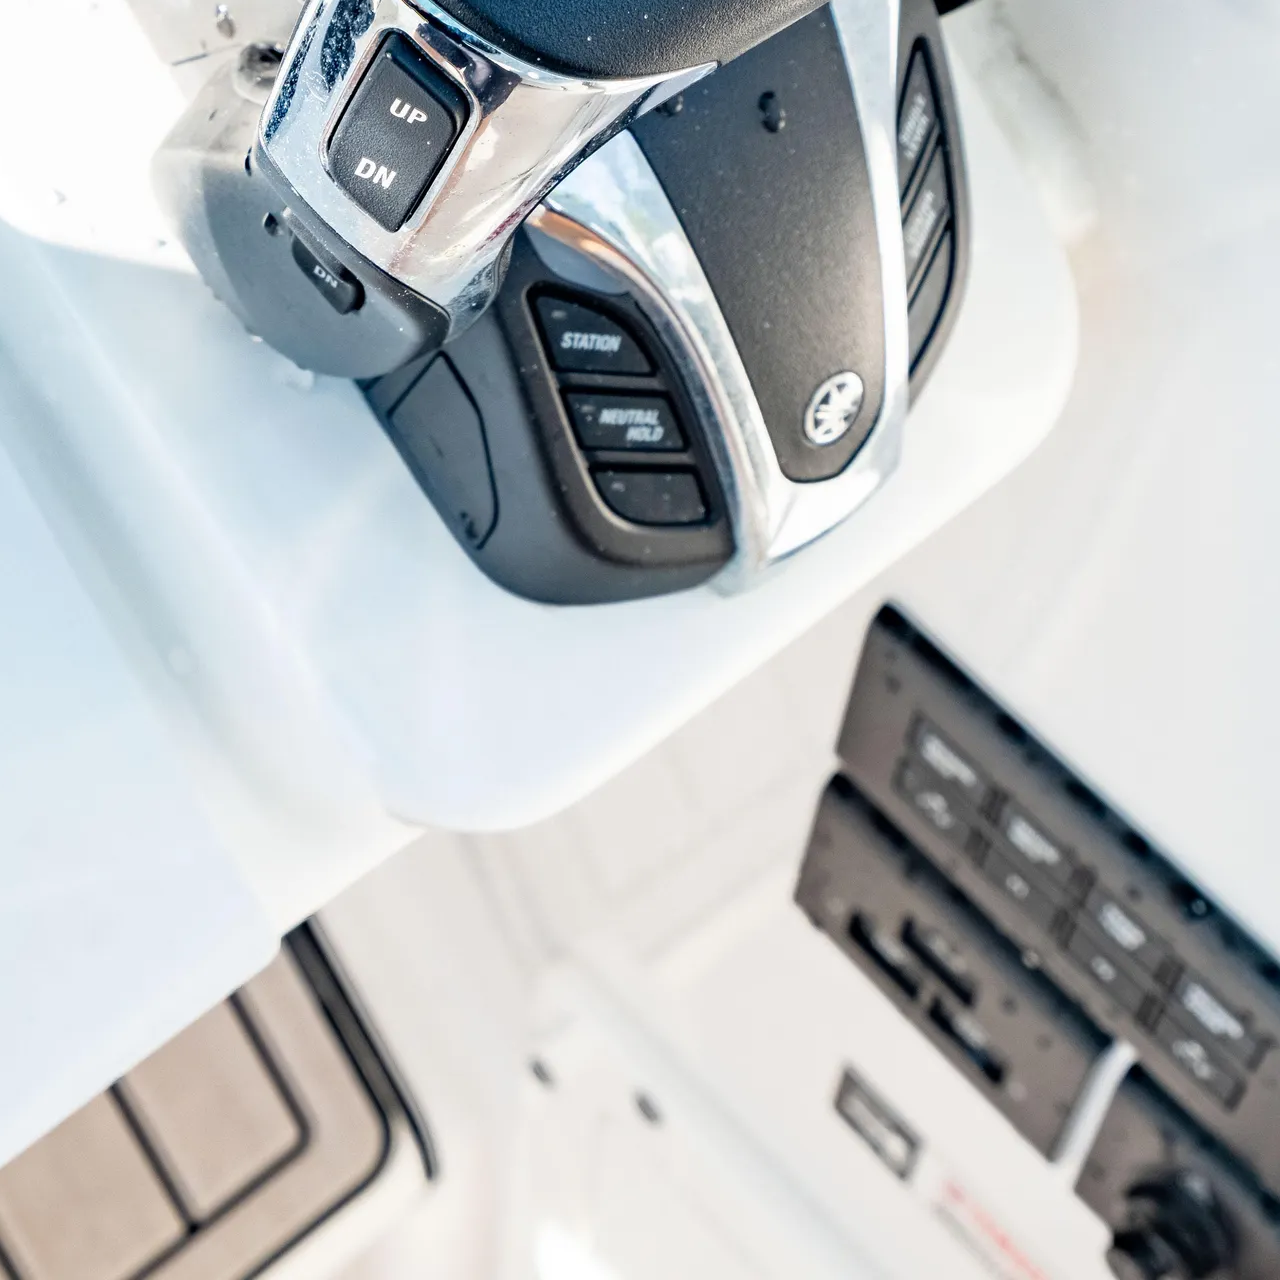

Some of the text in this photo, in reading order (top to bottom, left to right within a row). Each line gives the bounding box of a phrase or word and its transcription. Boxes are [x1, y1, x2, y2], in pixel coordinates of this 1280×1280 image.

[389, 97, 428, 124] UP
[354, 157, 397, 189] DN
[313, 265, 338, 288] DN
[560, 331, 621, 352] STATION
[598, 408, 660, 426] NEUTRAL
[626, 426, 665, 442] HOLD
